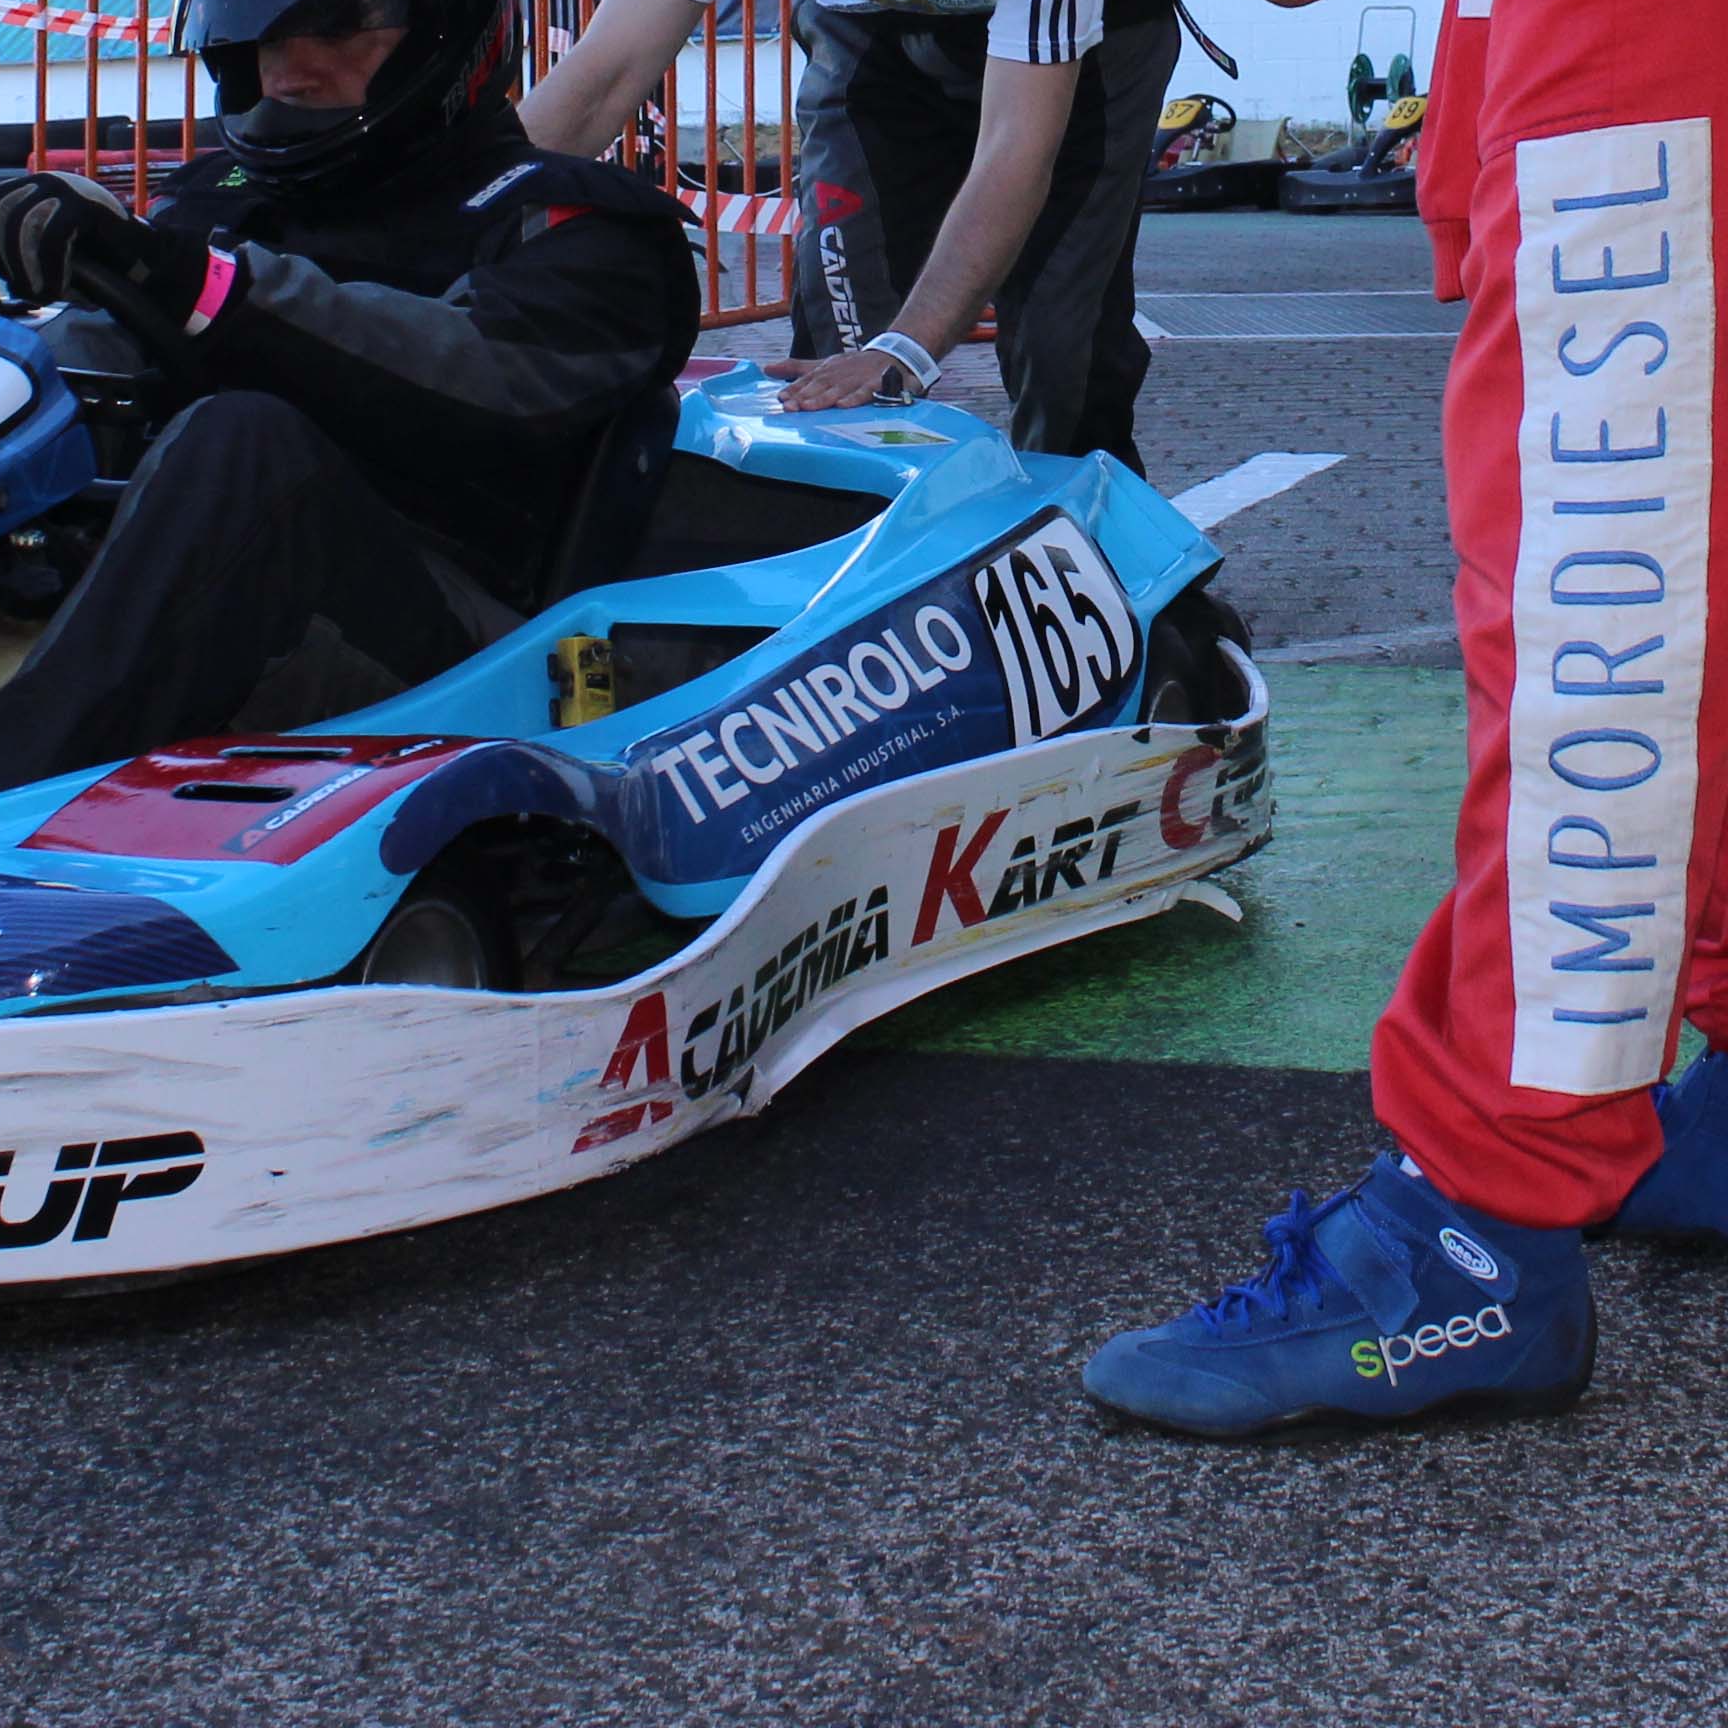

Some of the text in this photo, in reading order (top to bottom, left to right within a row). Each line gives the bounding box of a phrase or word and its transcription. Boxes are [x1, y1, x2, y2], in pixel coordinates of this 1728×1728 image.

[1392, 101, 1420, 120] 89
[815, 179, 865, 354] ACADEM
[984, 542, 1125, 739] 165
[1548, 140, 1669, 1024] IMPORDIESEL
[651, 604, 974, 825] TECNIROLO
[740, 703, 968, 846] ENGENHARIA INDUSTRIAL, S.A.
[571, 885, 890, 1155] ACADEMIA
[910, 799, 1142, 948] KART
[1350, 1303, 1513, 1387] speed
